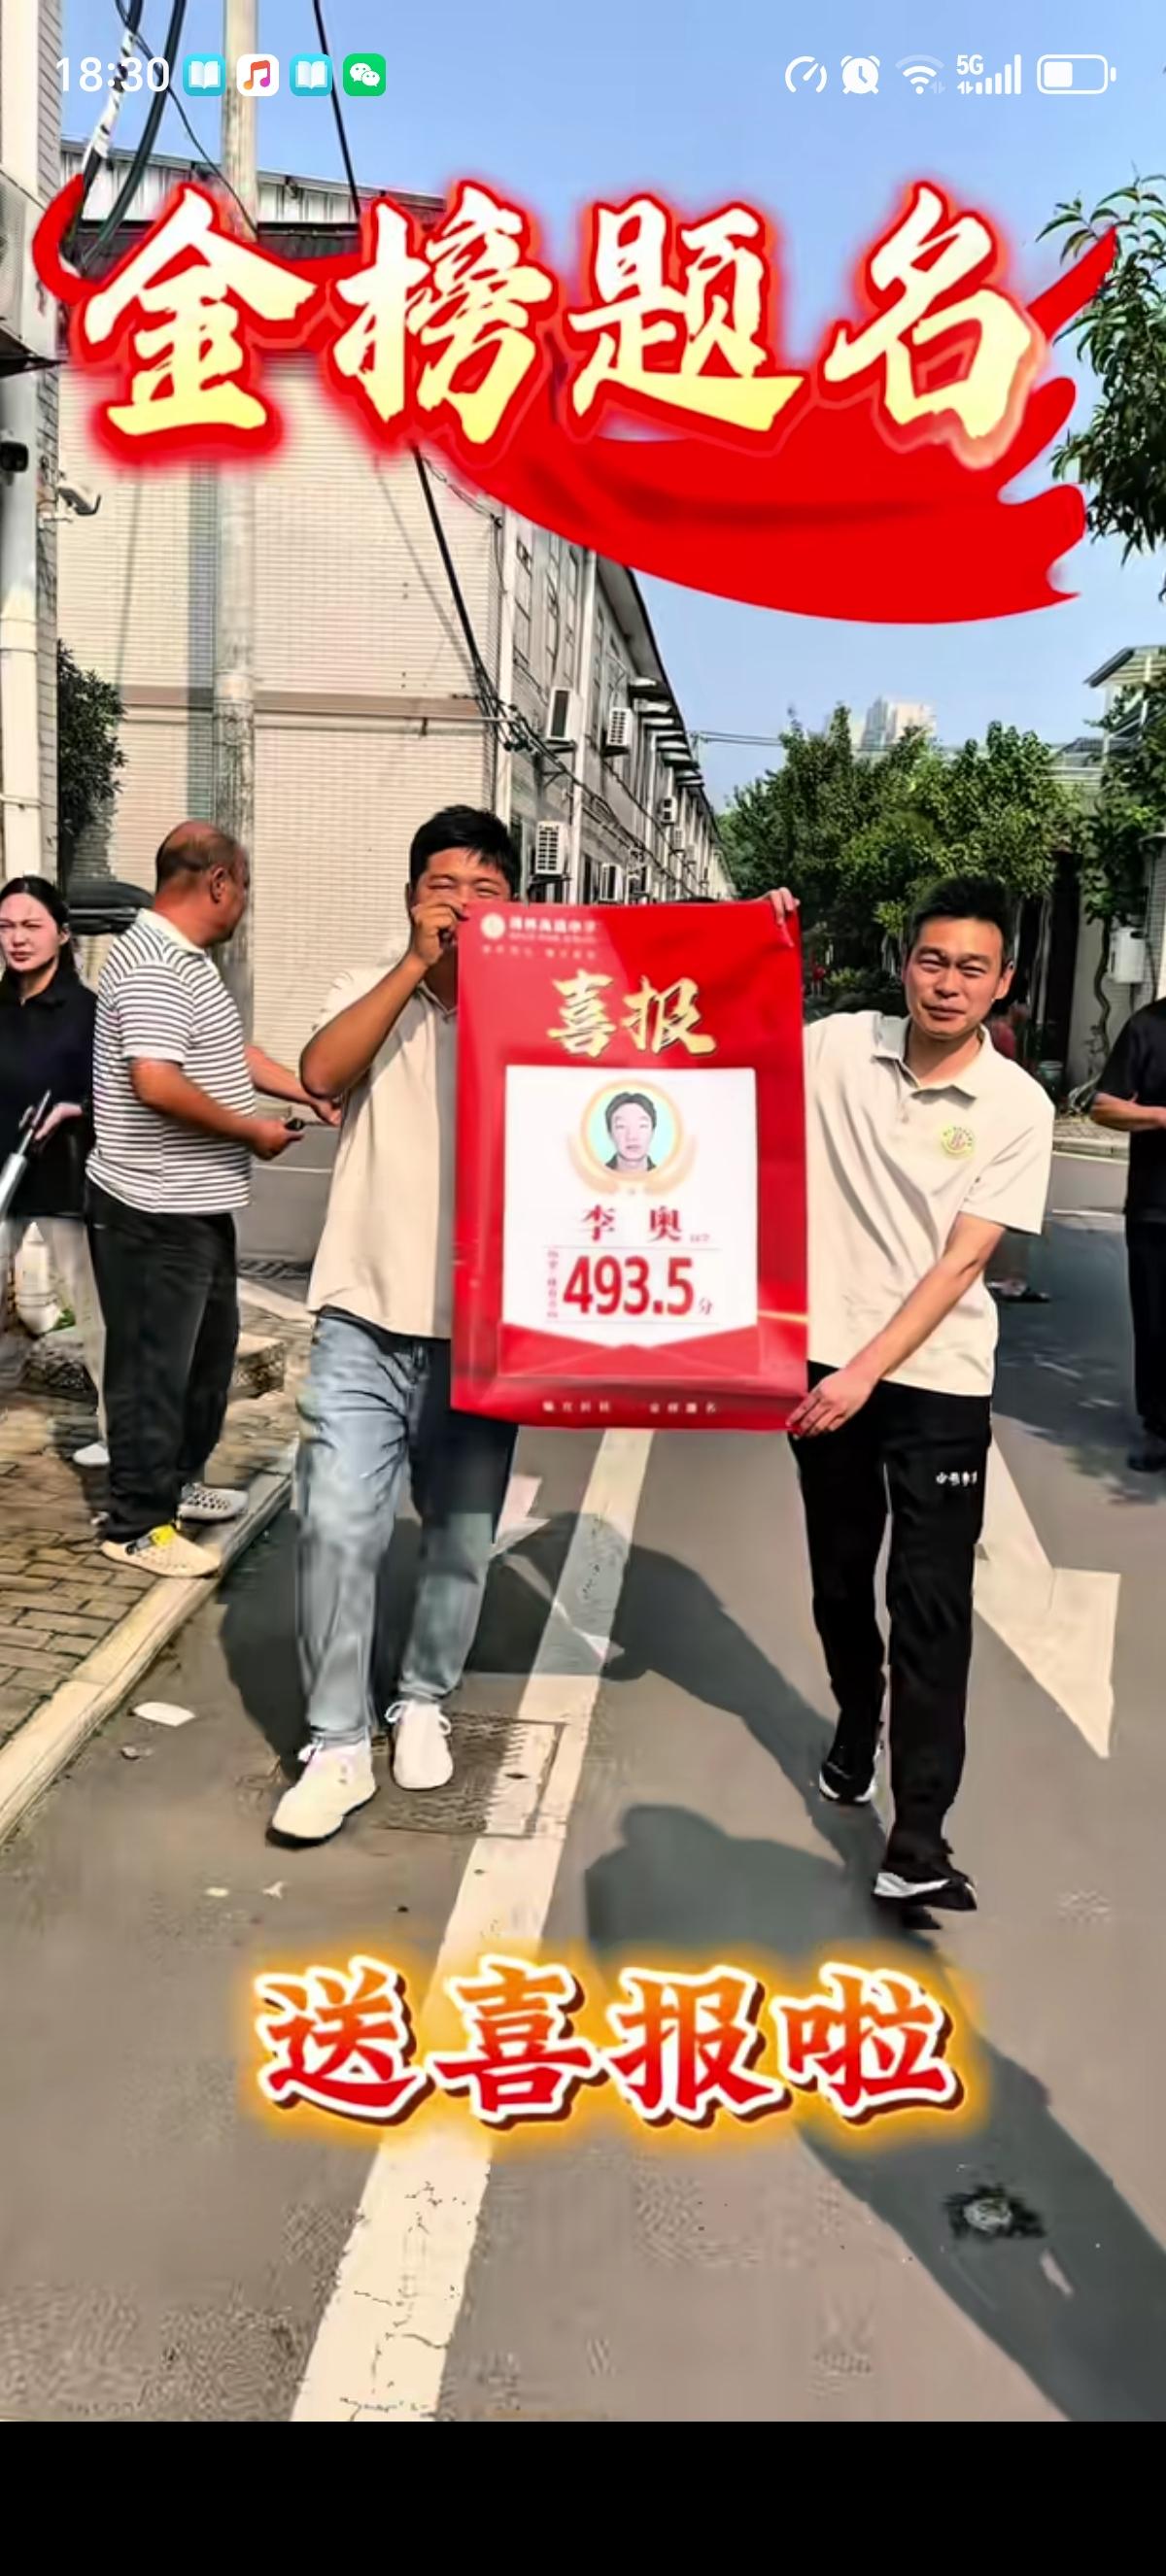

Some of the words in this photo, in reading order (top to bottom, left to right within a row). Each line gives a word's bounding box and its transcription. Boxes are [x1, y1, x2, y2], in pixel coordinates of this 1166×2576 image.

[547, 969, 717, 1057] 喜报
[580, 1204, 682, 1242] 李奥
[563, 1255, 695, 1316] 493.5
